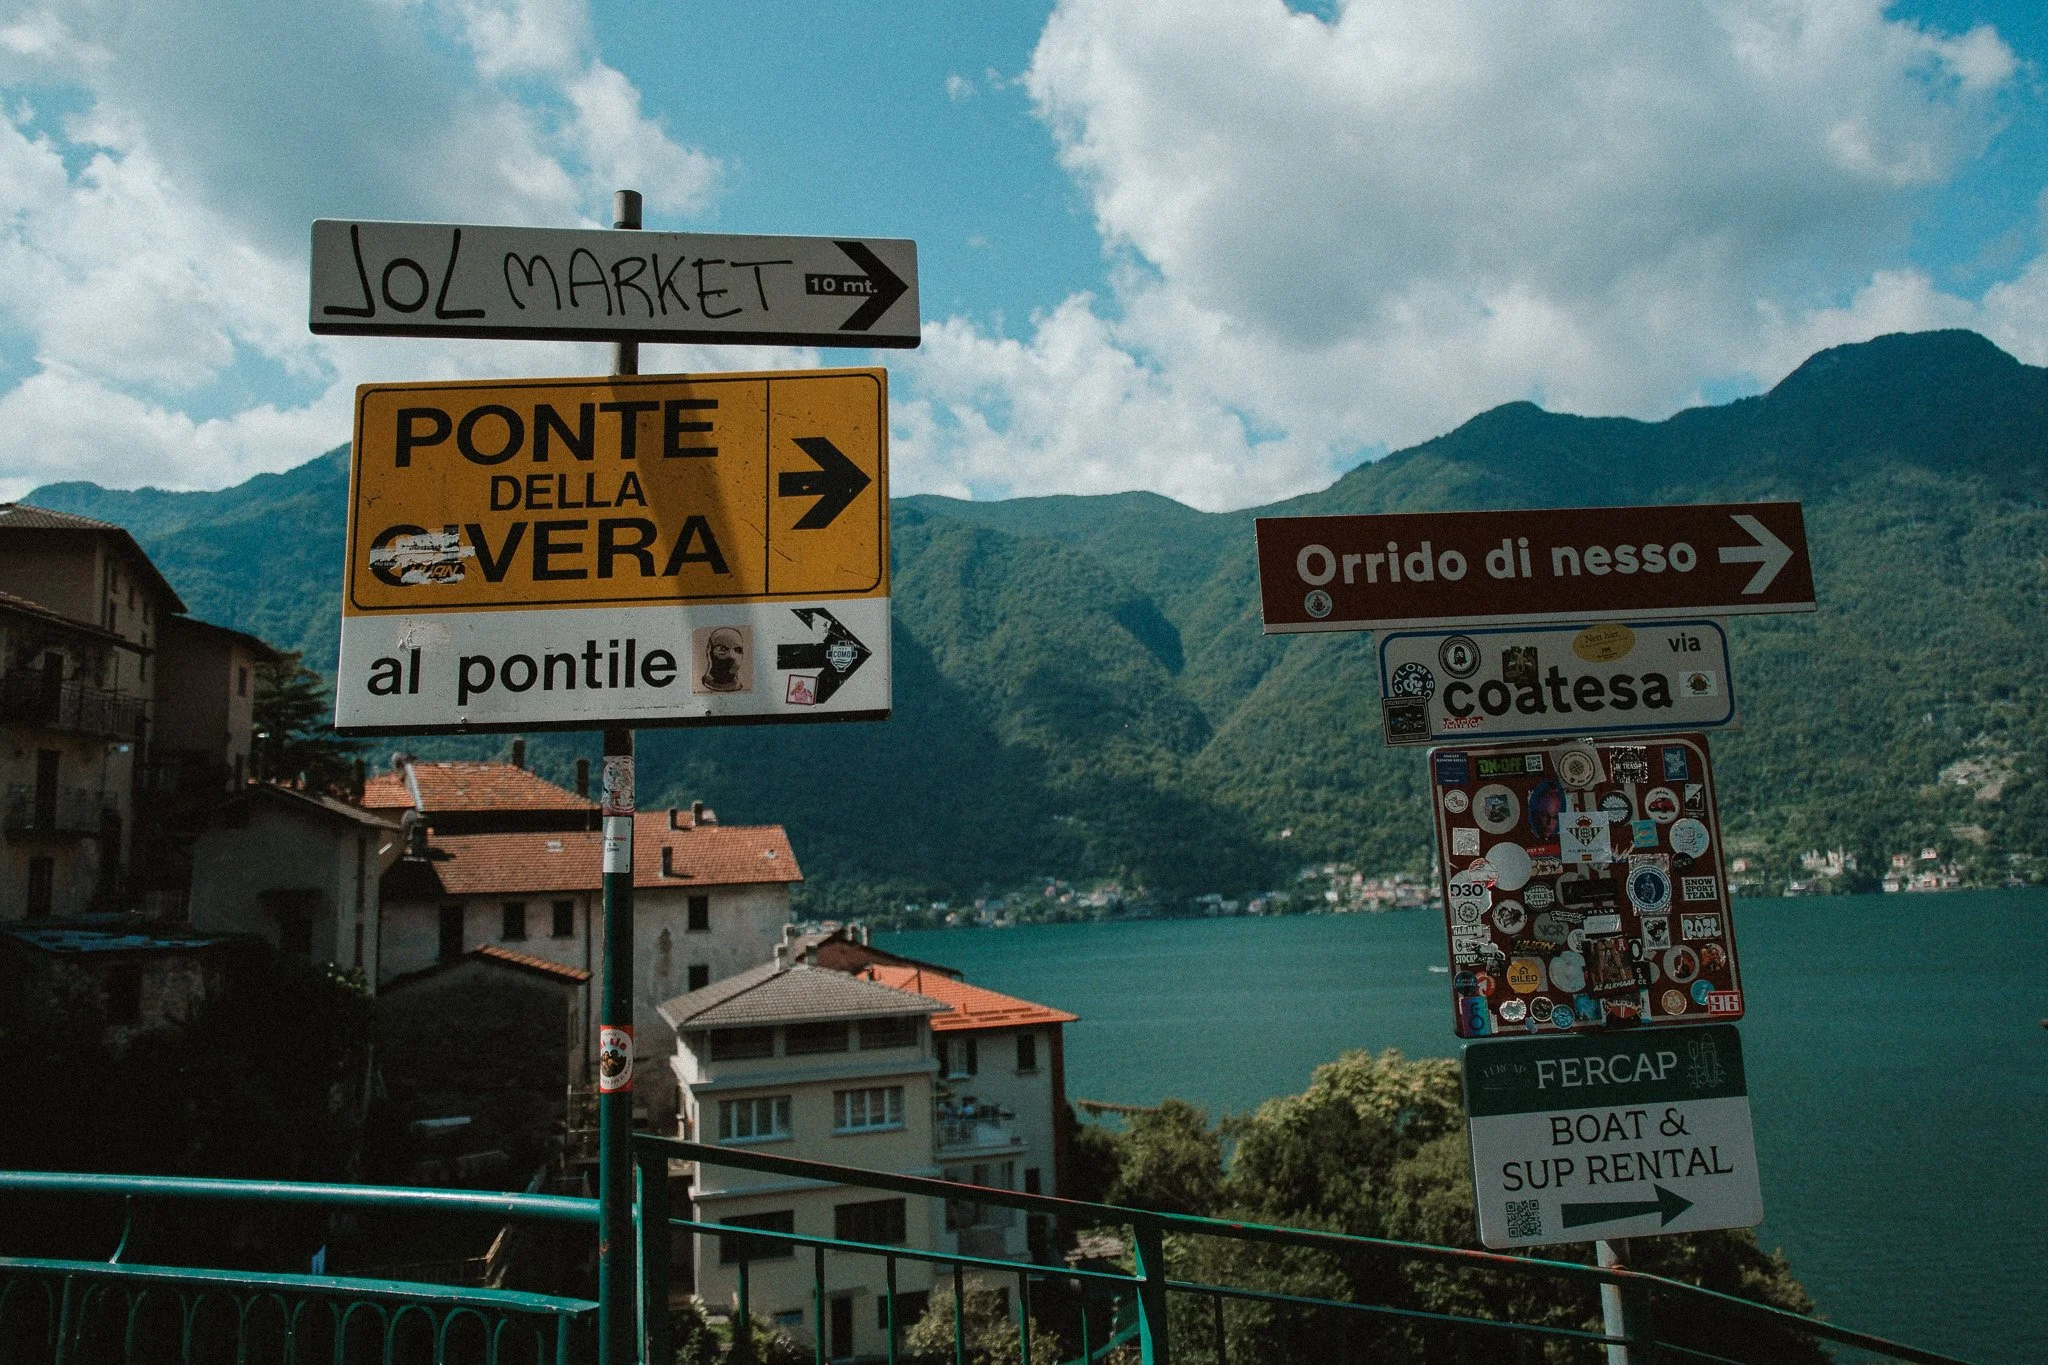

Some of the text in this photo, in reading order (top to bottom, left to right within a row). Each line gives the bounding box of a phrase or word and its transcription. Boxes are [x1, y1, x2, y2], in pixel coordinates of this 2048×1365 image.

[503, 248, 794, 319] MARKET
[809, 277, 879, 296] 10 mt.
[395, 399, 719, 468] PONTE
[489, 471, 649, 511] DELLA
[369, 515, 732, 587] CVERA
[1296, 536, 1698, 587] Orrido di nesso
[1667, 632, 1702, 653] via
[367, 638, 677, 706] al pontile
[1441, 664, 1674, 719] coatesa
[1685, 878, 1713, 886] SNOW
[1685, 885, 1714, 893] SPORT
[1686, 892, 1716, 900] TEAM
[1510, 974, 1538, 983] SILEO
[1604, 978, 1635, 990] ALKMAAR
[1710, 994, 1740, 1012] 96
[1535, 1050, 1678, 1090] FERCAP
[1549, 1107, 1692, 1146] BOAT &
[1502, 1145, 1734, 1192] SUP RENTAL
